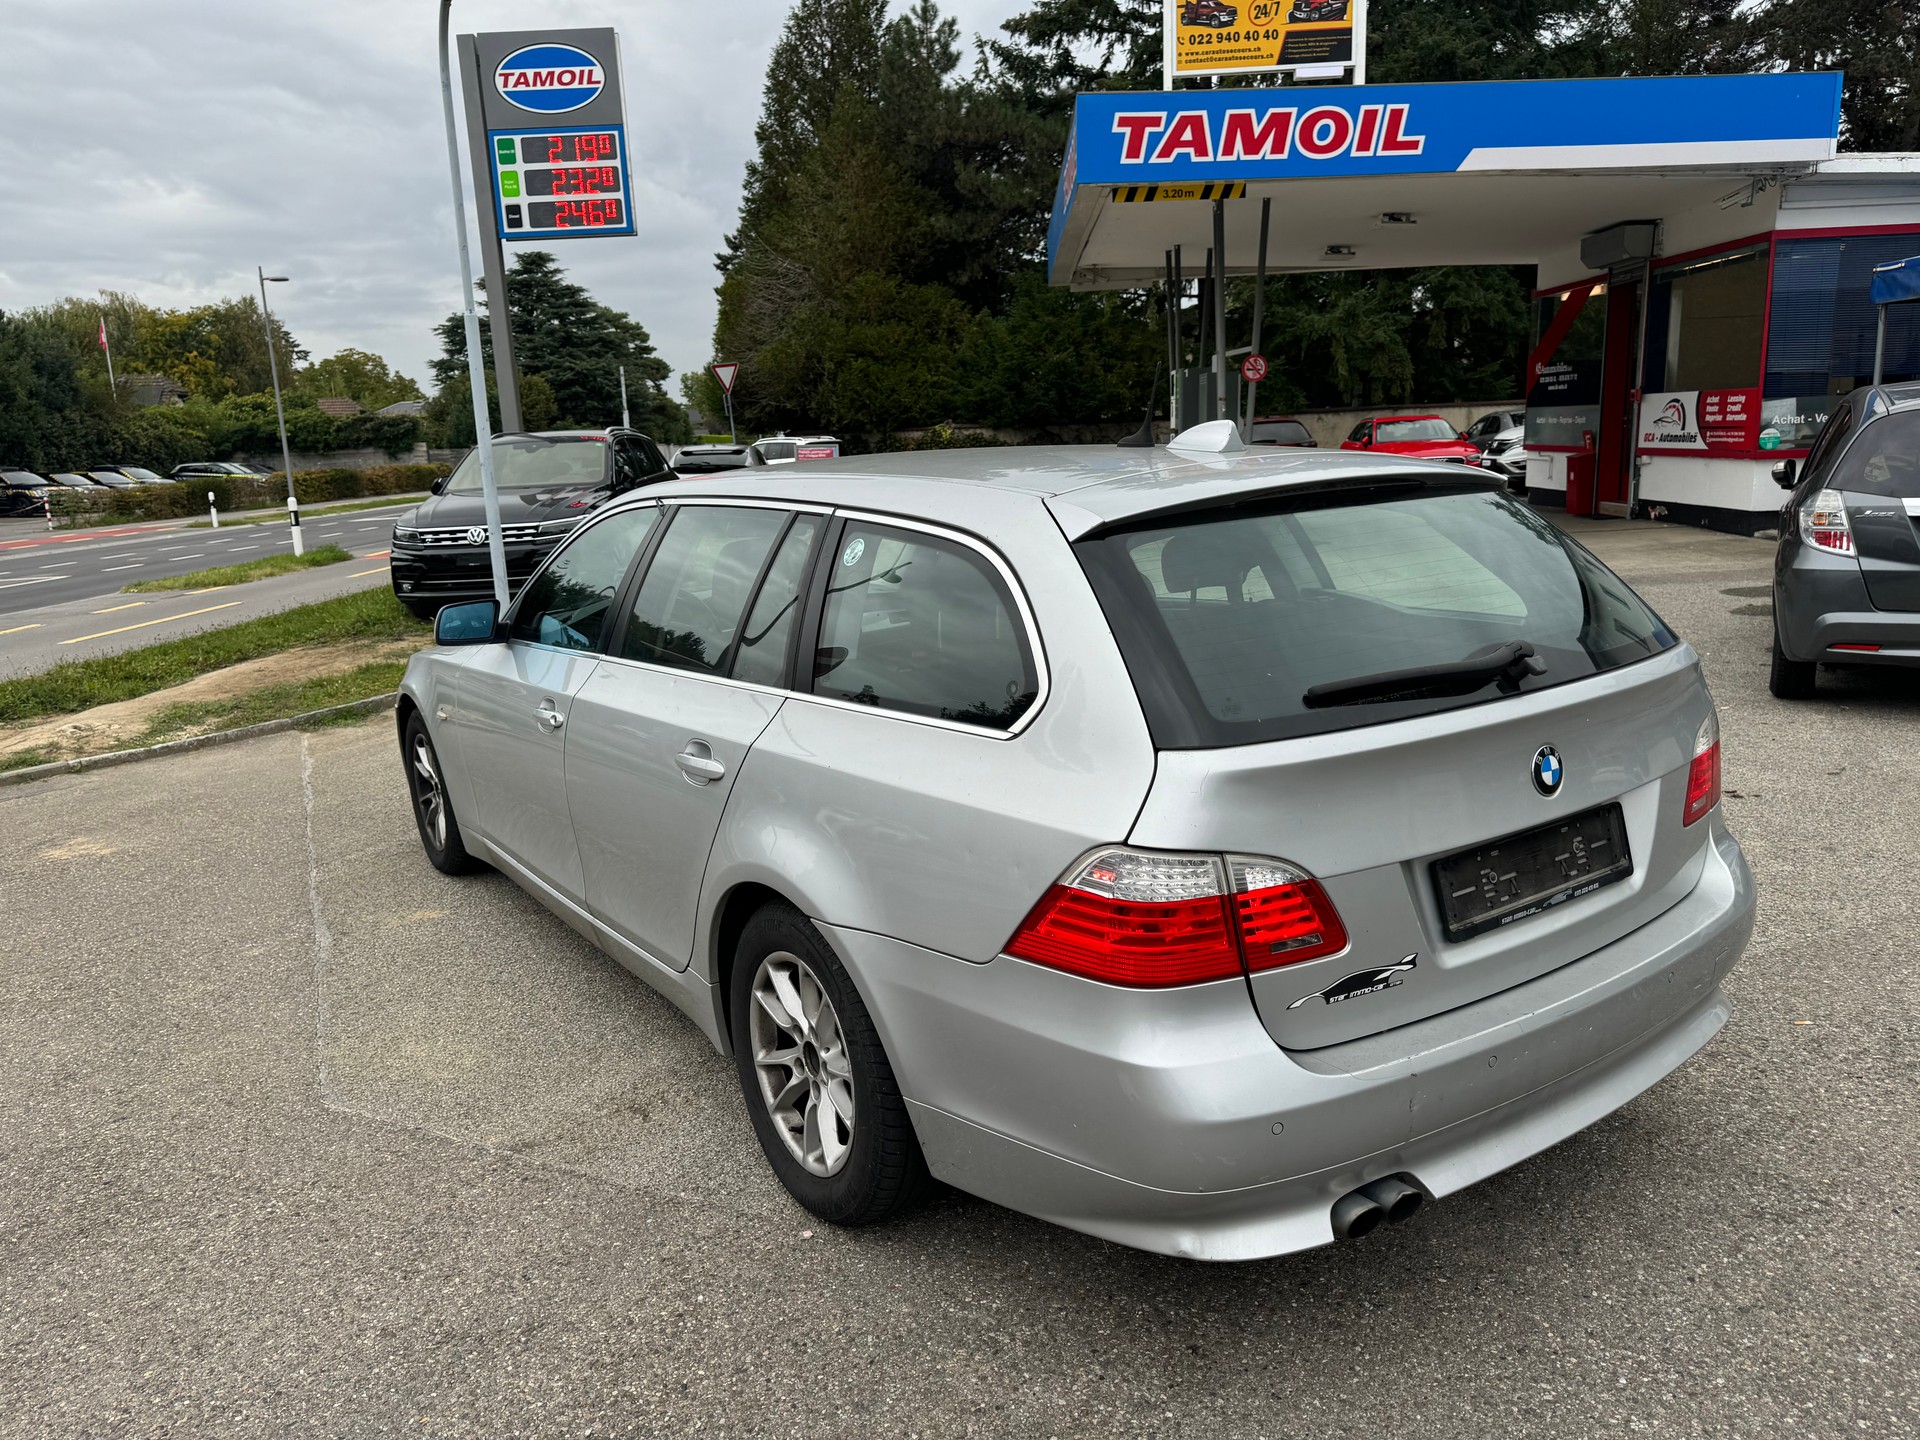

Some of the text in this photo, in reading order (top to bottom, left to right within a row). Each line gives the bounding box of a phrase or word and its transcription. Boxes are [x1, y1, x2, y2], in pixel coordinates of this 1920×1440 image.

[1254, 1, 1280, 19] 24/7
[1189, 34, 1213, 45] 022
[1216, 31, 1240, 43] 940
[1244, 30, 1259, 41] 40
[1263, 29, 1279, 40] 40
[1185, 47, 1261, 56] www.carautosecours.ch
[498, 69, 602, 88] TAMOIL
[1112, 104, 1426, 164] TAMOIL
[1163, 189, 1194, 198] 3.20 m
[1183, 369, 1189, 378] 1
[1771, 414, 1806, 424] Achat
[1815, 413, 1829, 423] Ve
[1659, 432, 1698, 443] Automobiles
